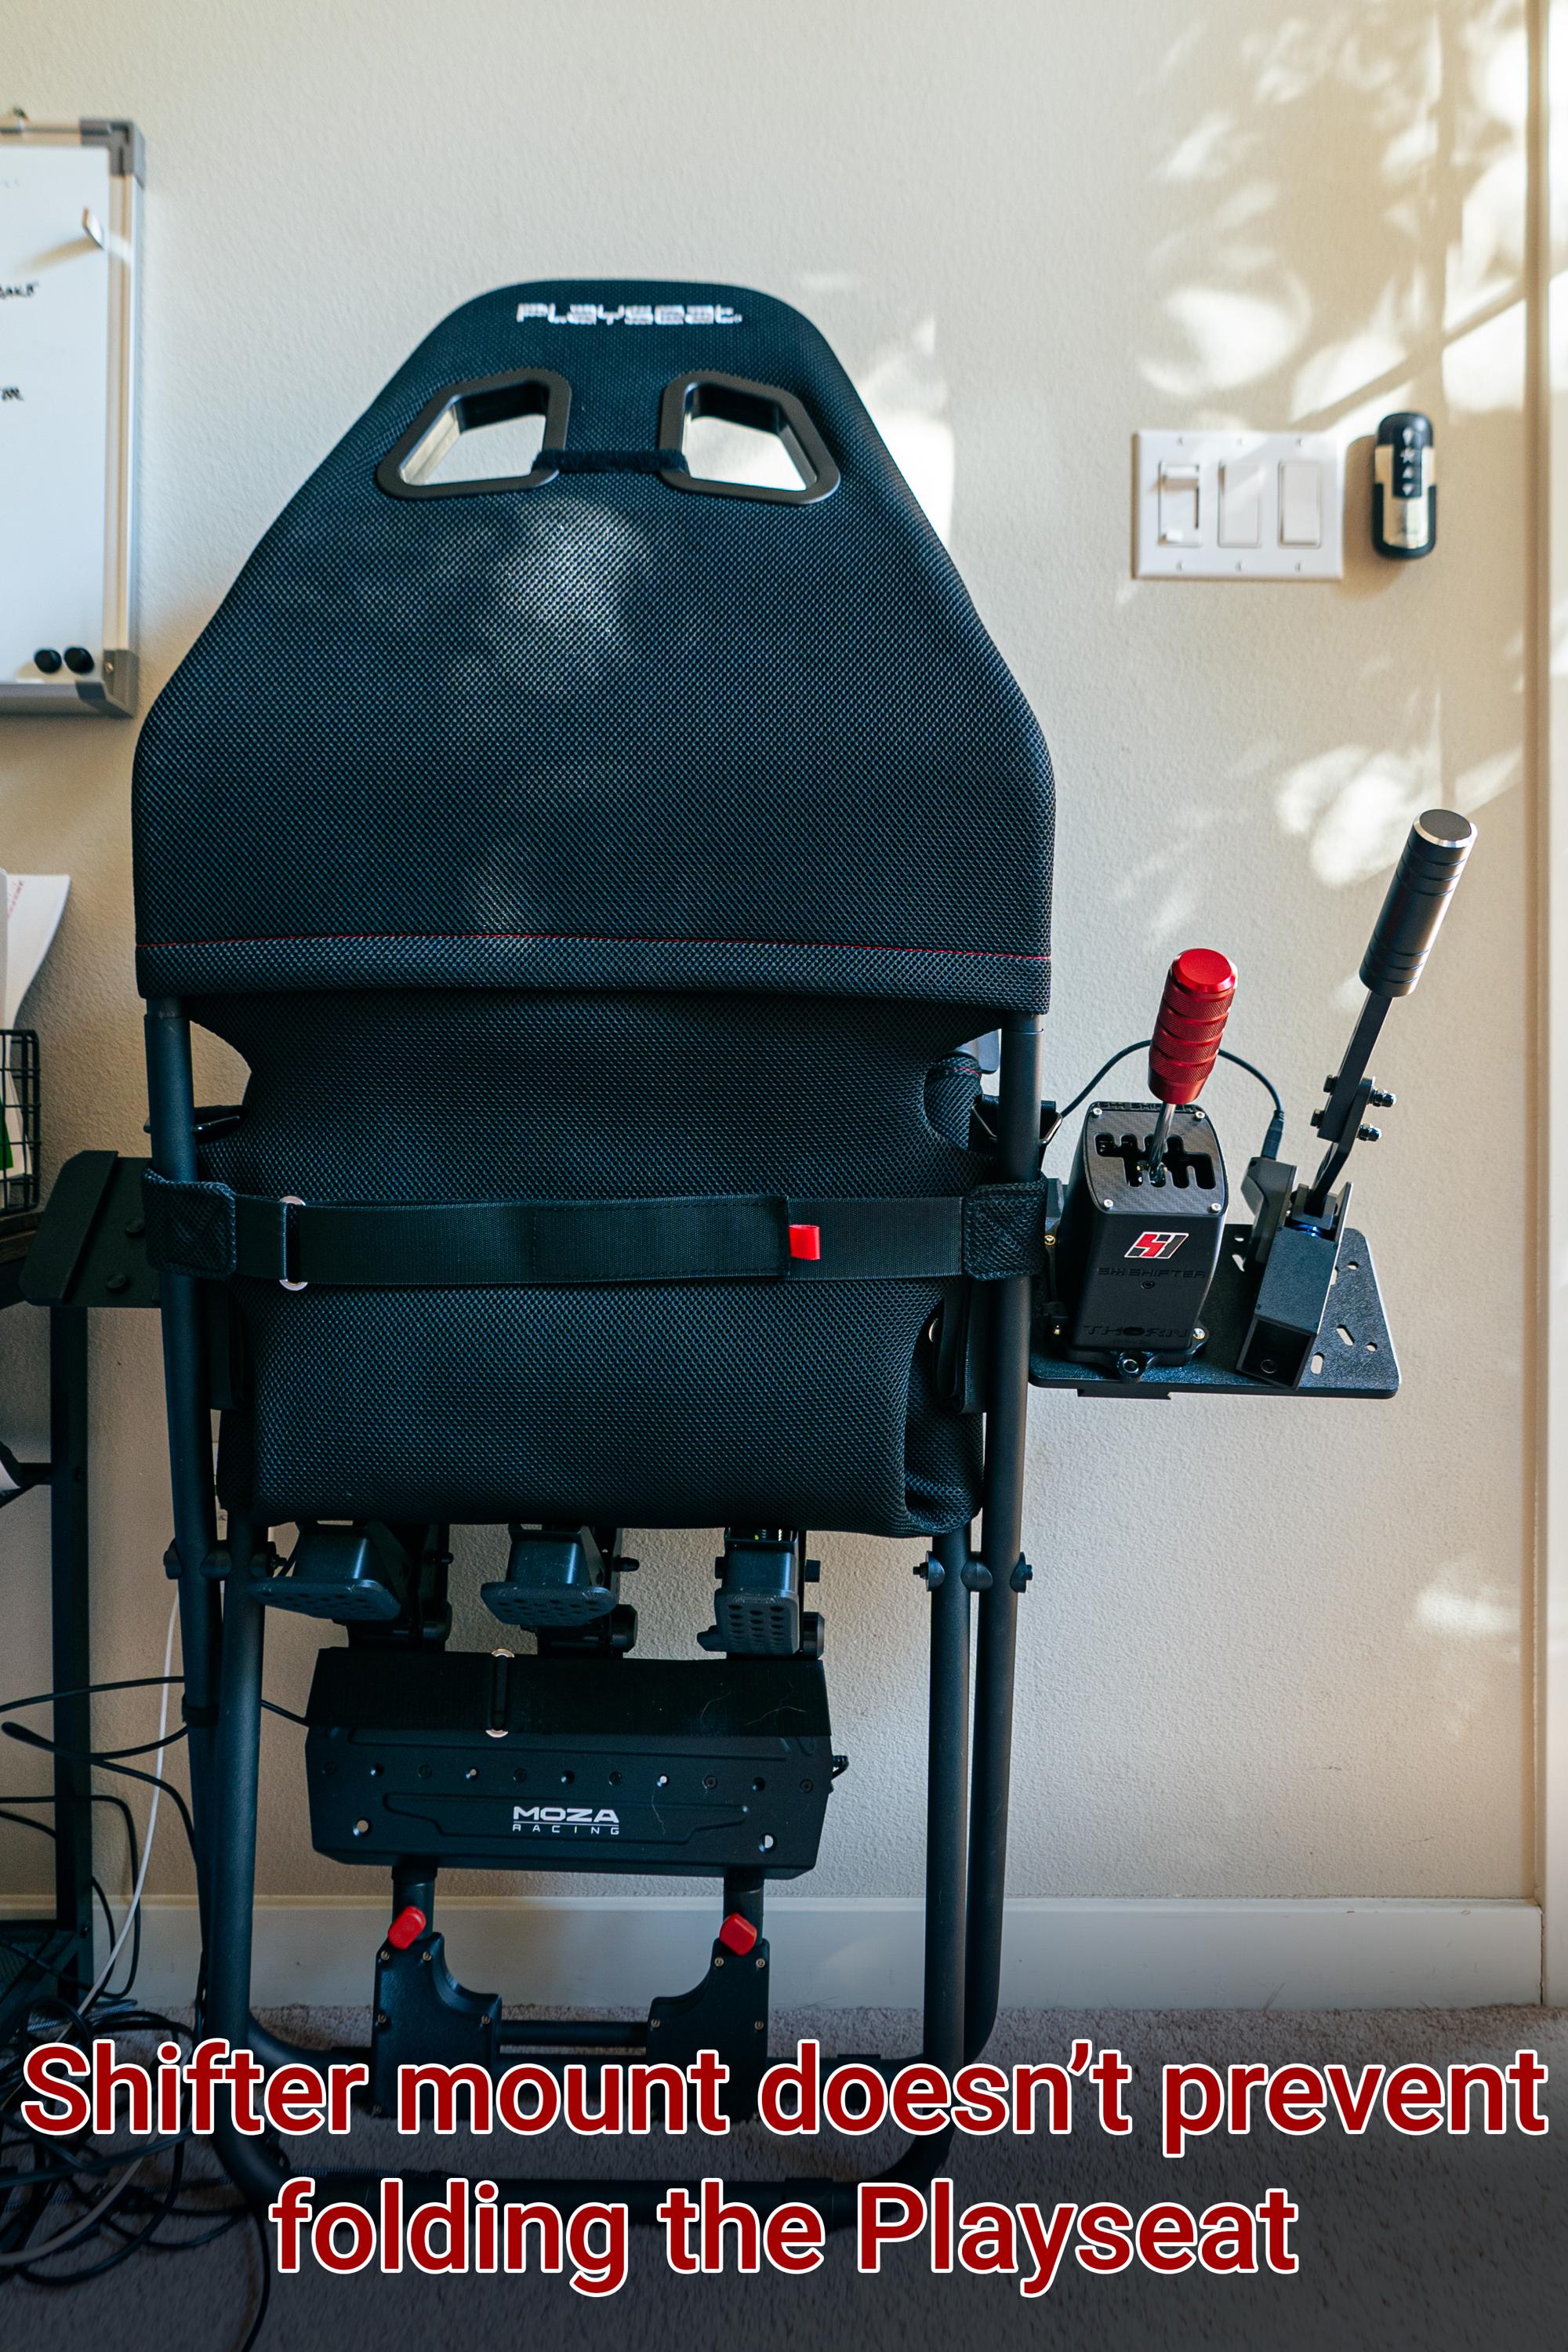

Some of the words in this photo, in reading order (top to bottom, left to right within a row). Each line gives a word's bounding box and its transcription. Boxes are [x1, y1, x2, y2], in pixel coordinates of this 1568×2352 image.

[1128, 1268, 1206, 1278] SHIFTER
[1083, 1325, 1189, 1339] THORN
[513, 1806, 619, 1824] MOZA
[512, 1824, 619, 1835] RACING
